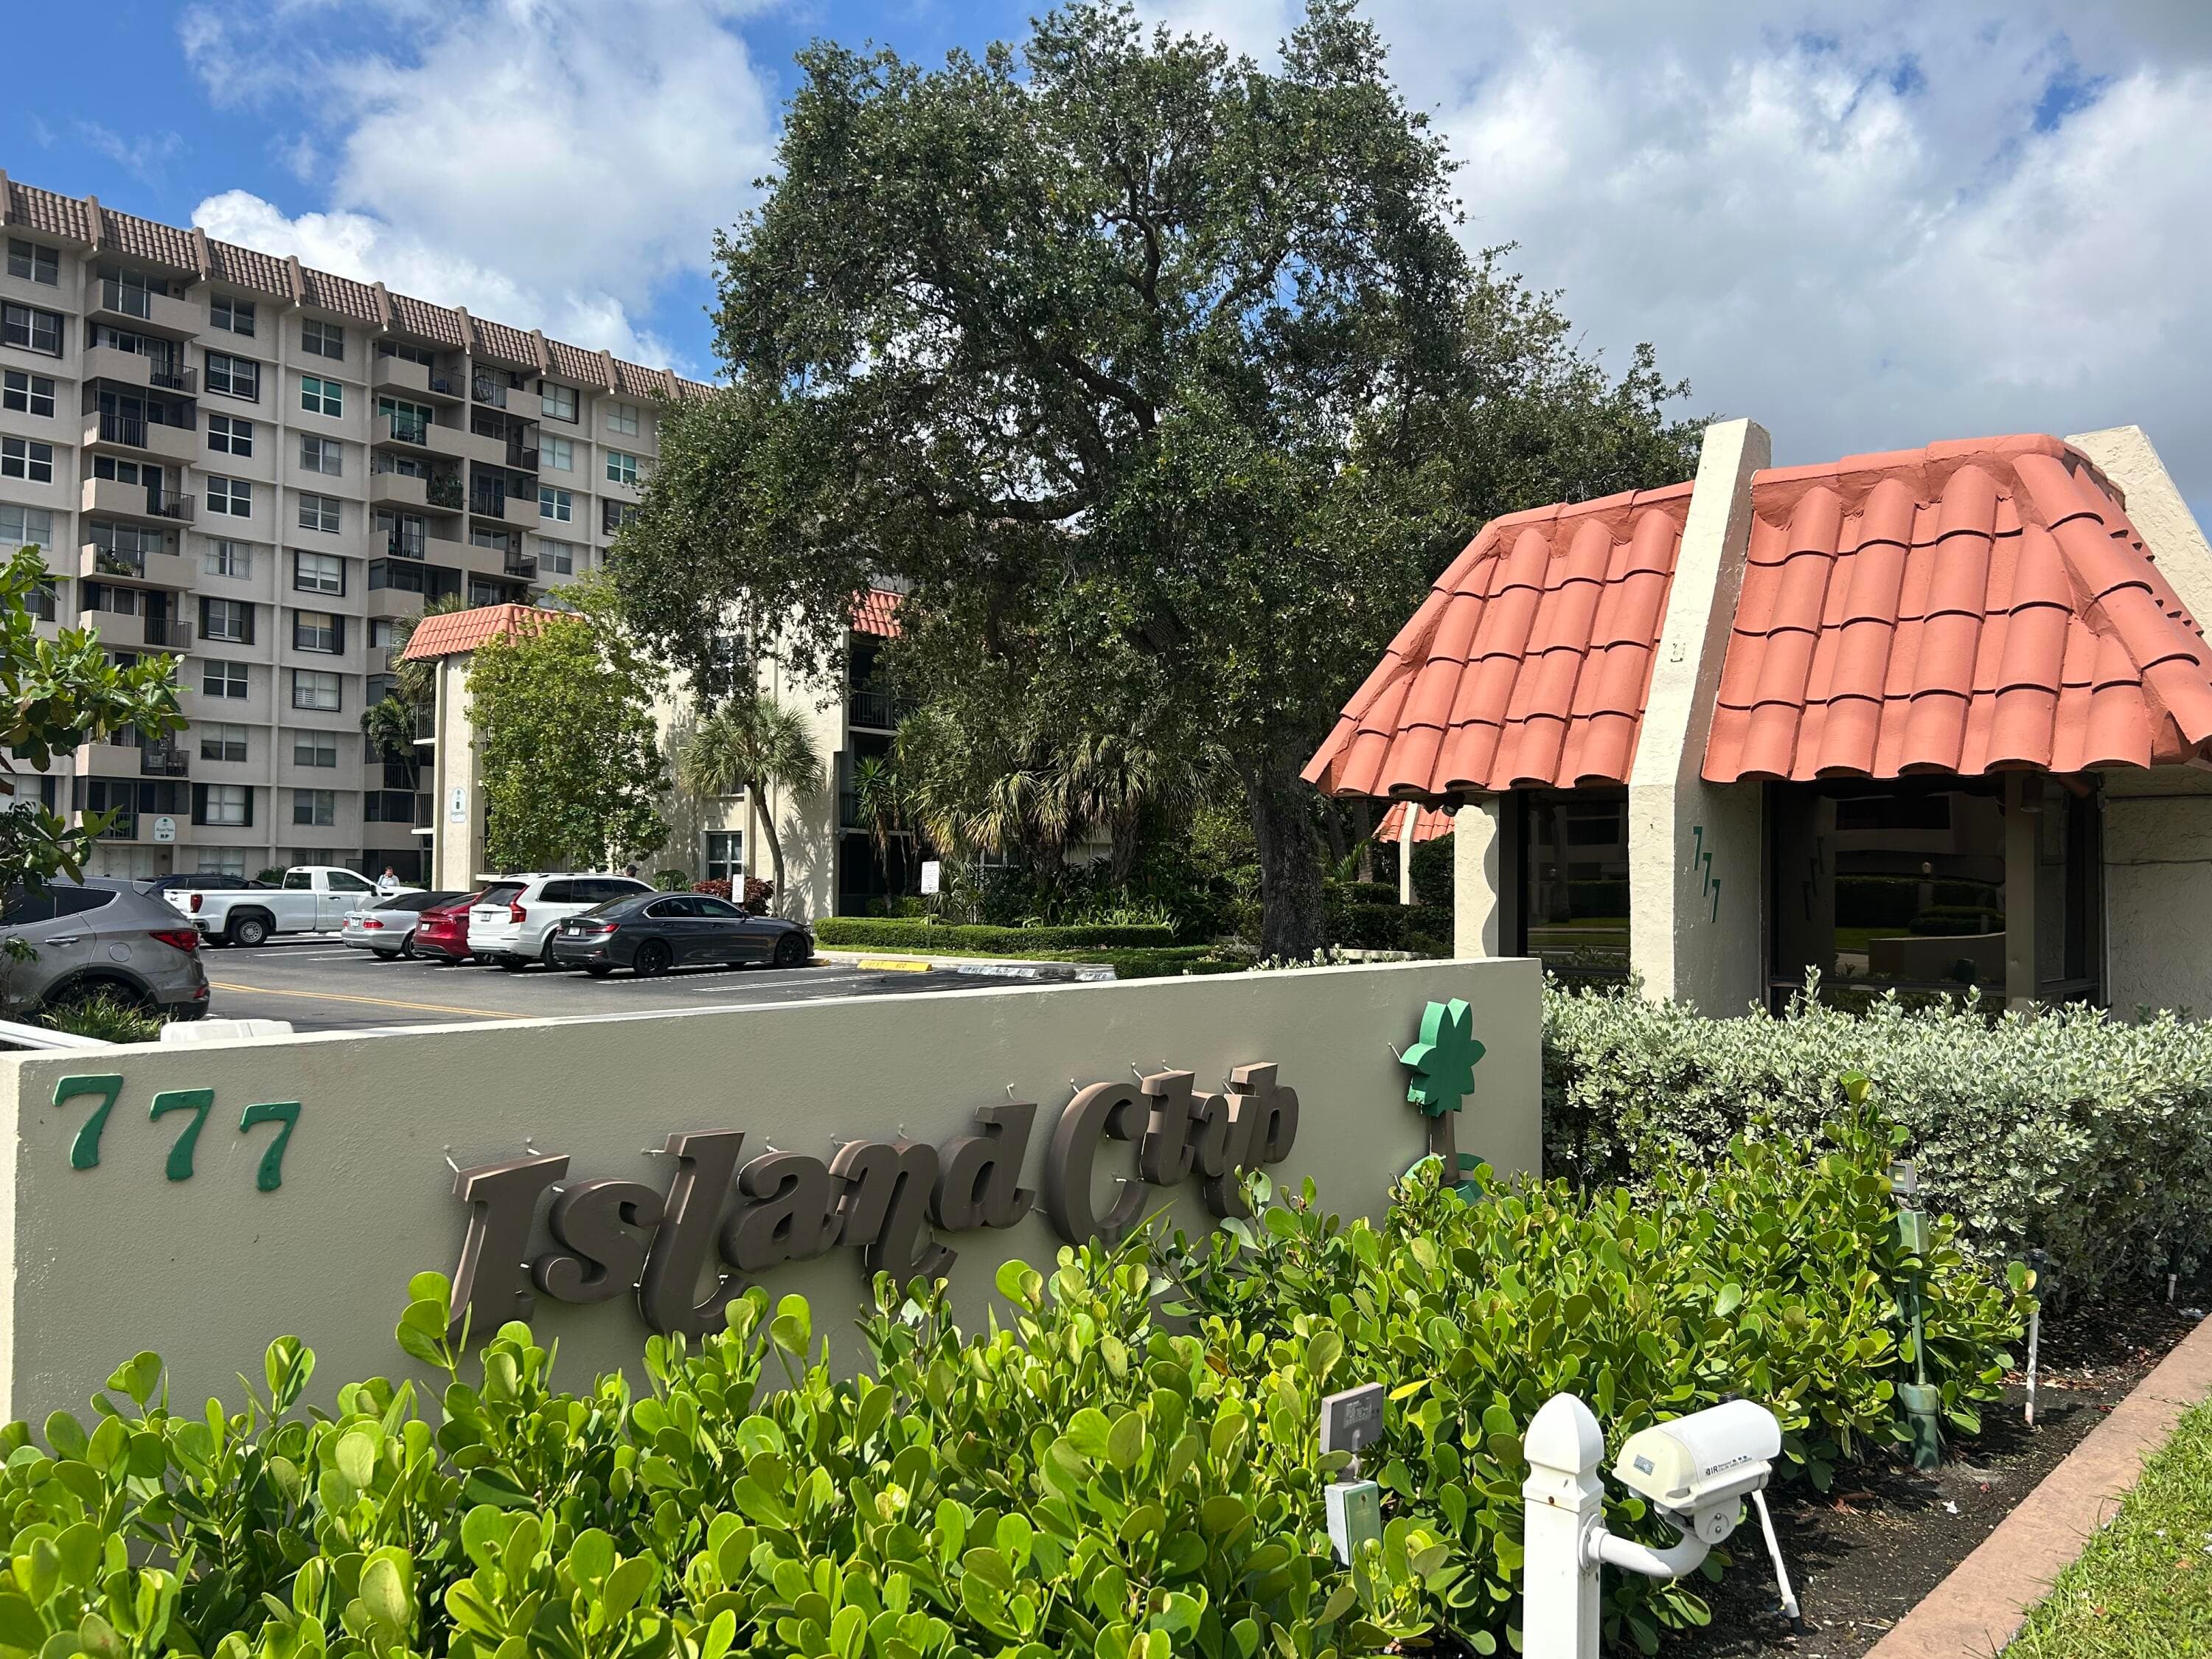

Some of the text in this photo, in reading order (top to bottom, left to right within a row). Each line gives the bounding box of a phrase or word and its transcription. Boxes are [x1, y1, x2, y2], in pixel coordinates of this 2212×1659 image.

[1692, 826, 1721, 923] 777
[52, 1073, 302, 1192] 777
[450, 1062, 1299, 1343] Island Club
